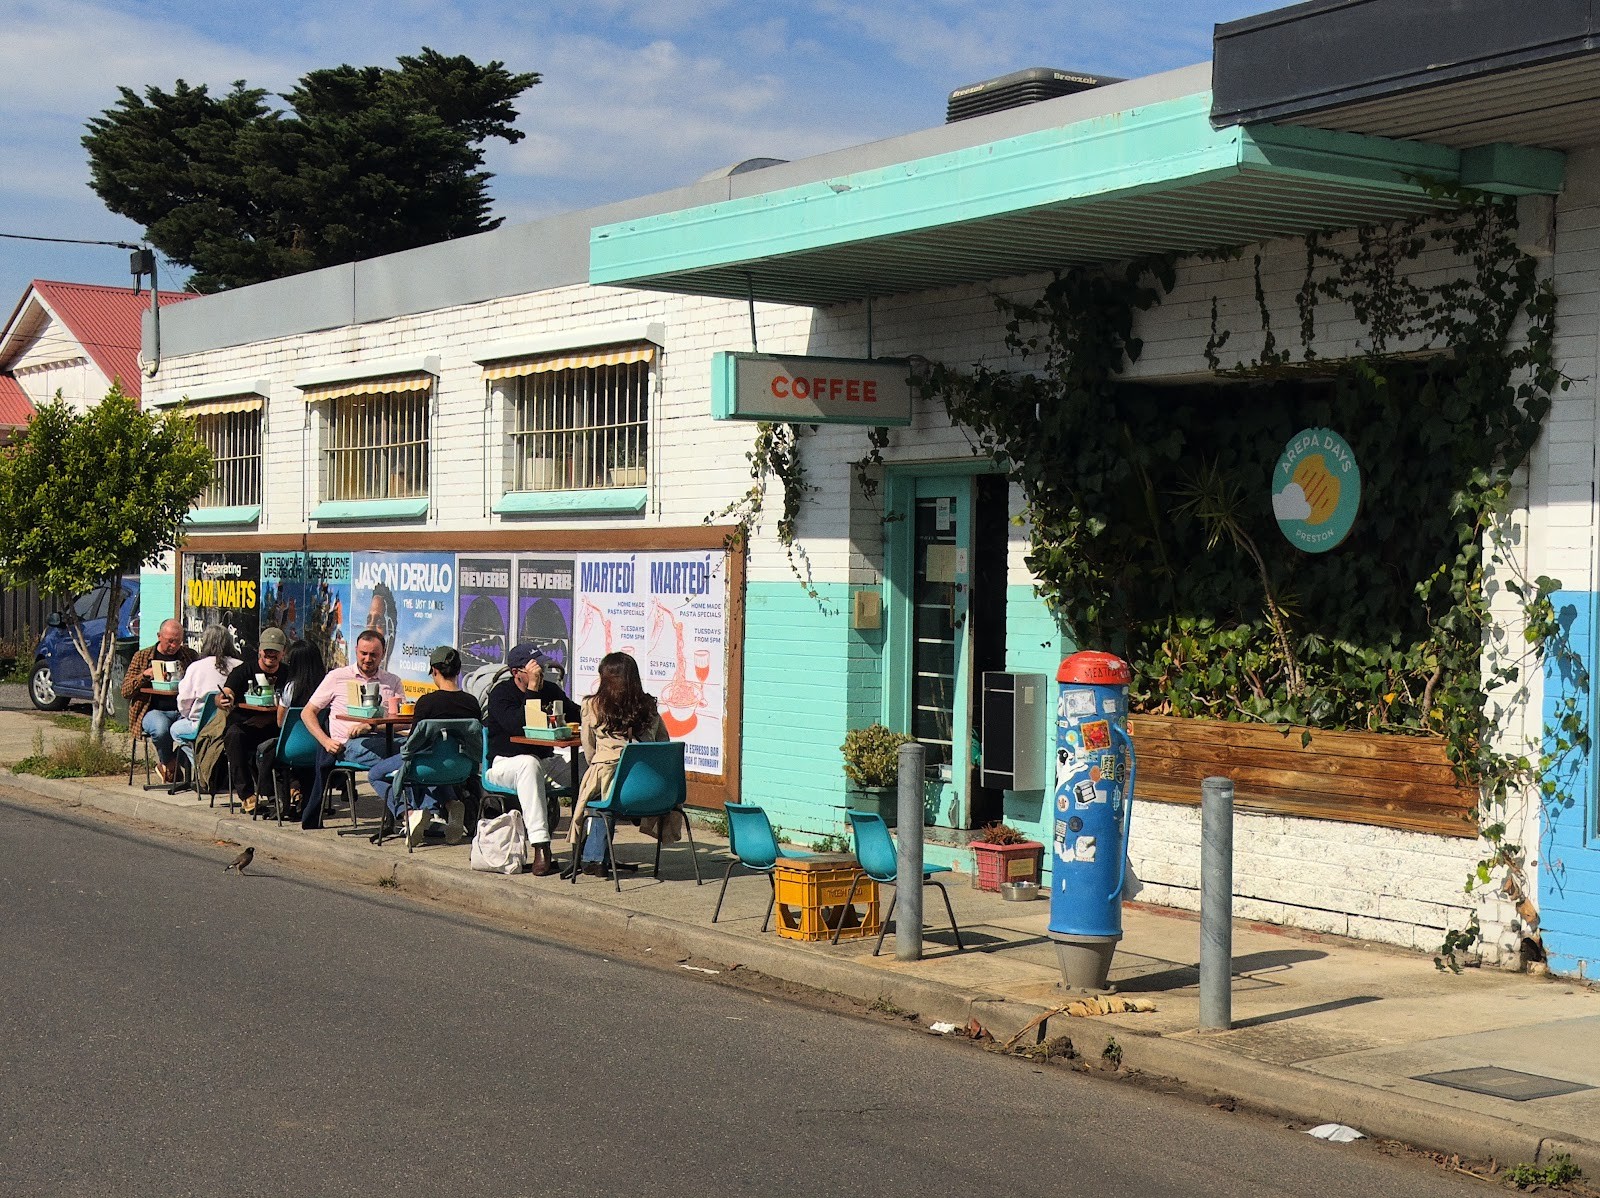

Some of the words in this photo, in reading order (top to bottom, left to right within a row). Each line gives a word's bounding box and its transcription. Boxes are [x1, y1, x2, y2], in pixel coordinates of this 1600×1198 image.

[1054, 72, 1098, 86] Breezair
[952, 84, 985, 98] Breezair
[771, 375, 877, 403] COFFEE
[1282, 434, 1320, 474] AREPA
[1324, 436, 1352, 472] DAYS
[1296, 529, 1335, 543] PRESTON
[202, 562, 242, 578] Celebrating
[334, 569, 350, 580] OUT
[355, 562, 398, 591] JASON
[400, 562, 452, 594] DERULO
[460, 572, 508, 588] REVERB
[520, 572, 572, 590] REVERB
[187, 580, 214, 608] TOM
[216, 580, 256, 609] WAITS
[188, 616, 204, 632] Max
[690, 744, 709, 756] ESPRESSO
[710, 746, 719, 757] BAR
